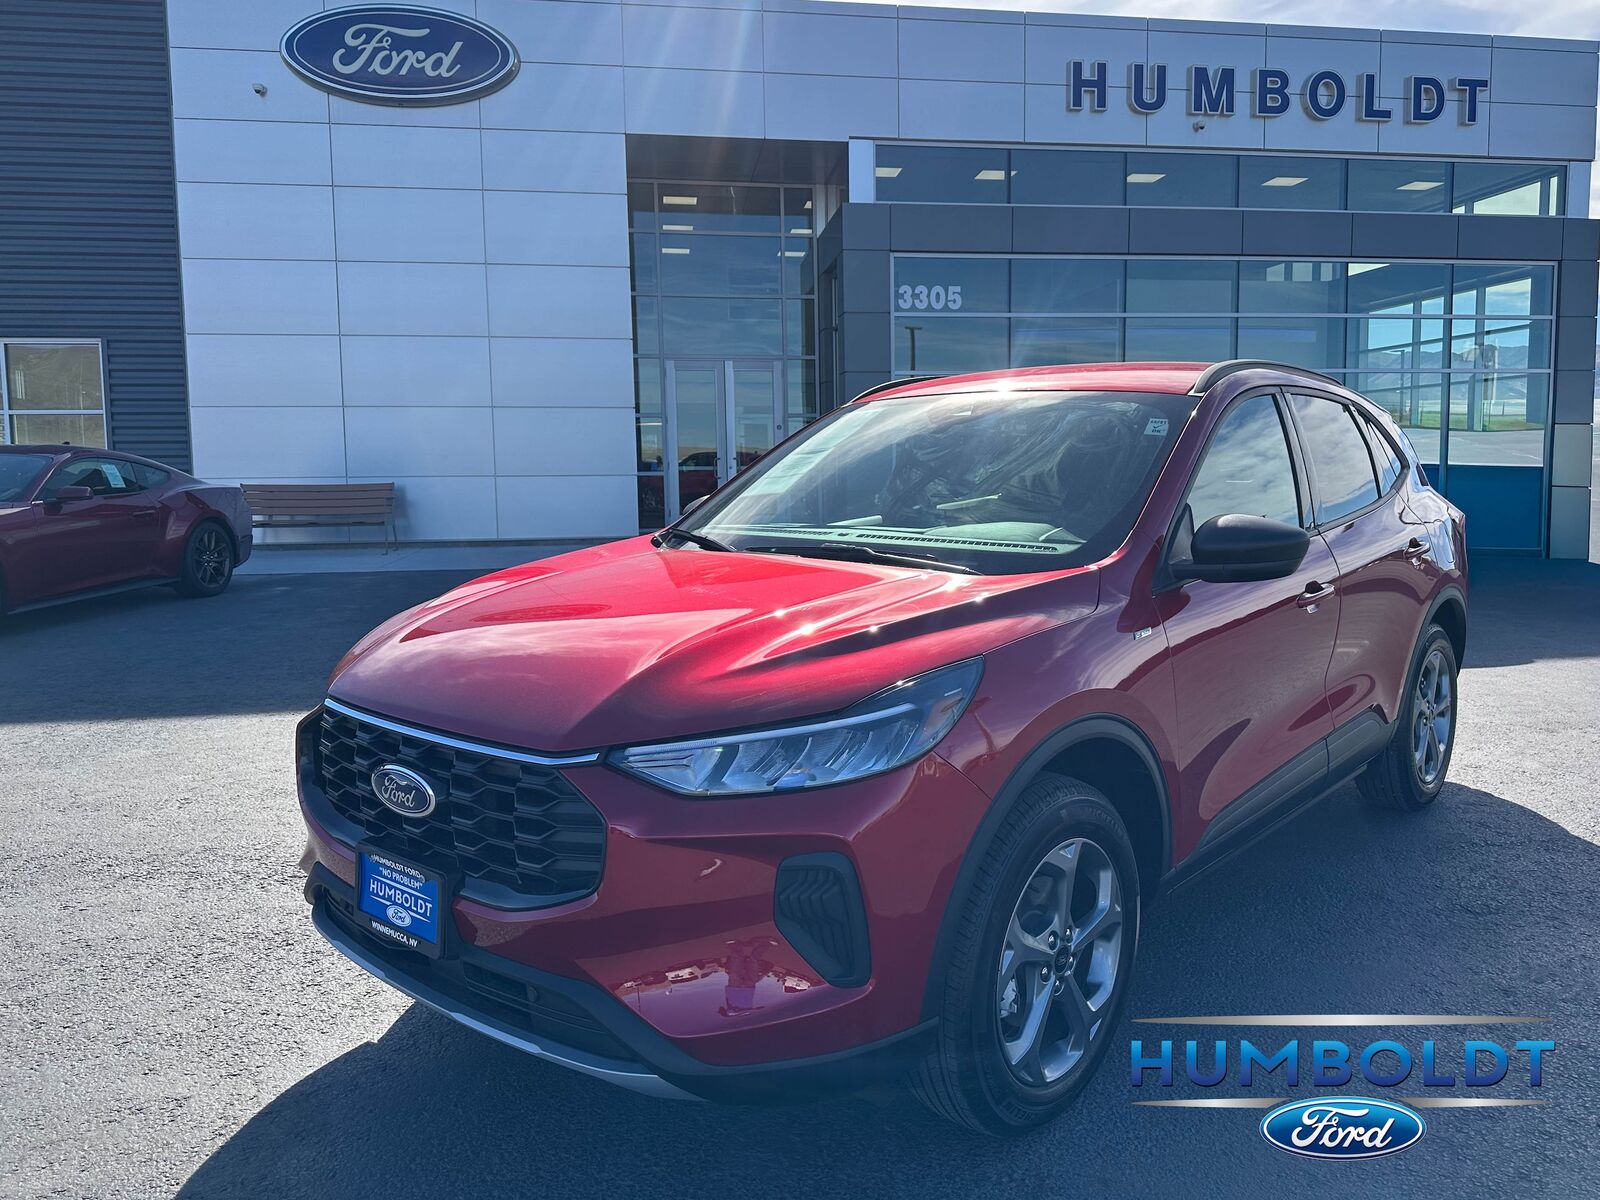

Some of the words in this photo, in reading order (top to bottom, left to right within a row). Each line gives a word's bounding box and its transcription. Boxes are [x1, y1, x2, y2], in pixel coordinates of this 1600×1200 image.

[332, 23, 464, 79] Ford
[1067, 58, 1489, 126] HUMBOLDT
[898, 284, 962, 310] 3305
[381, 774, 417, 808] Ford
[374, 854, 404, 872] HUMBOLDT
[369, 878, 433, 917] HUMBOLDT
